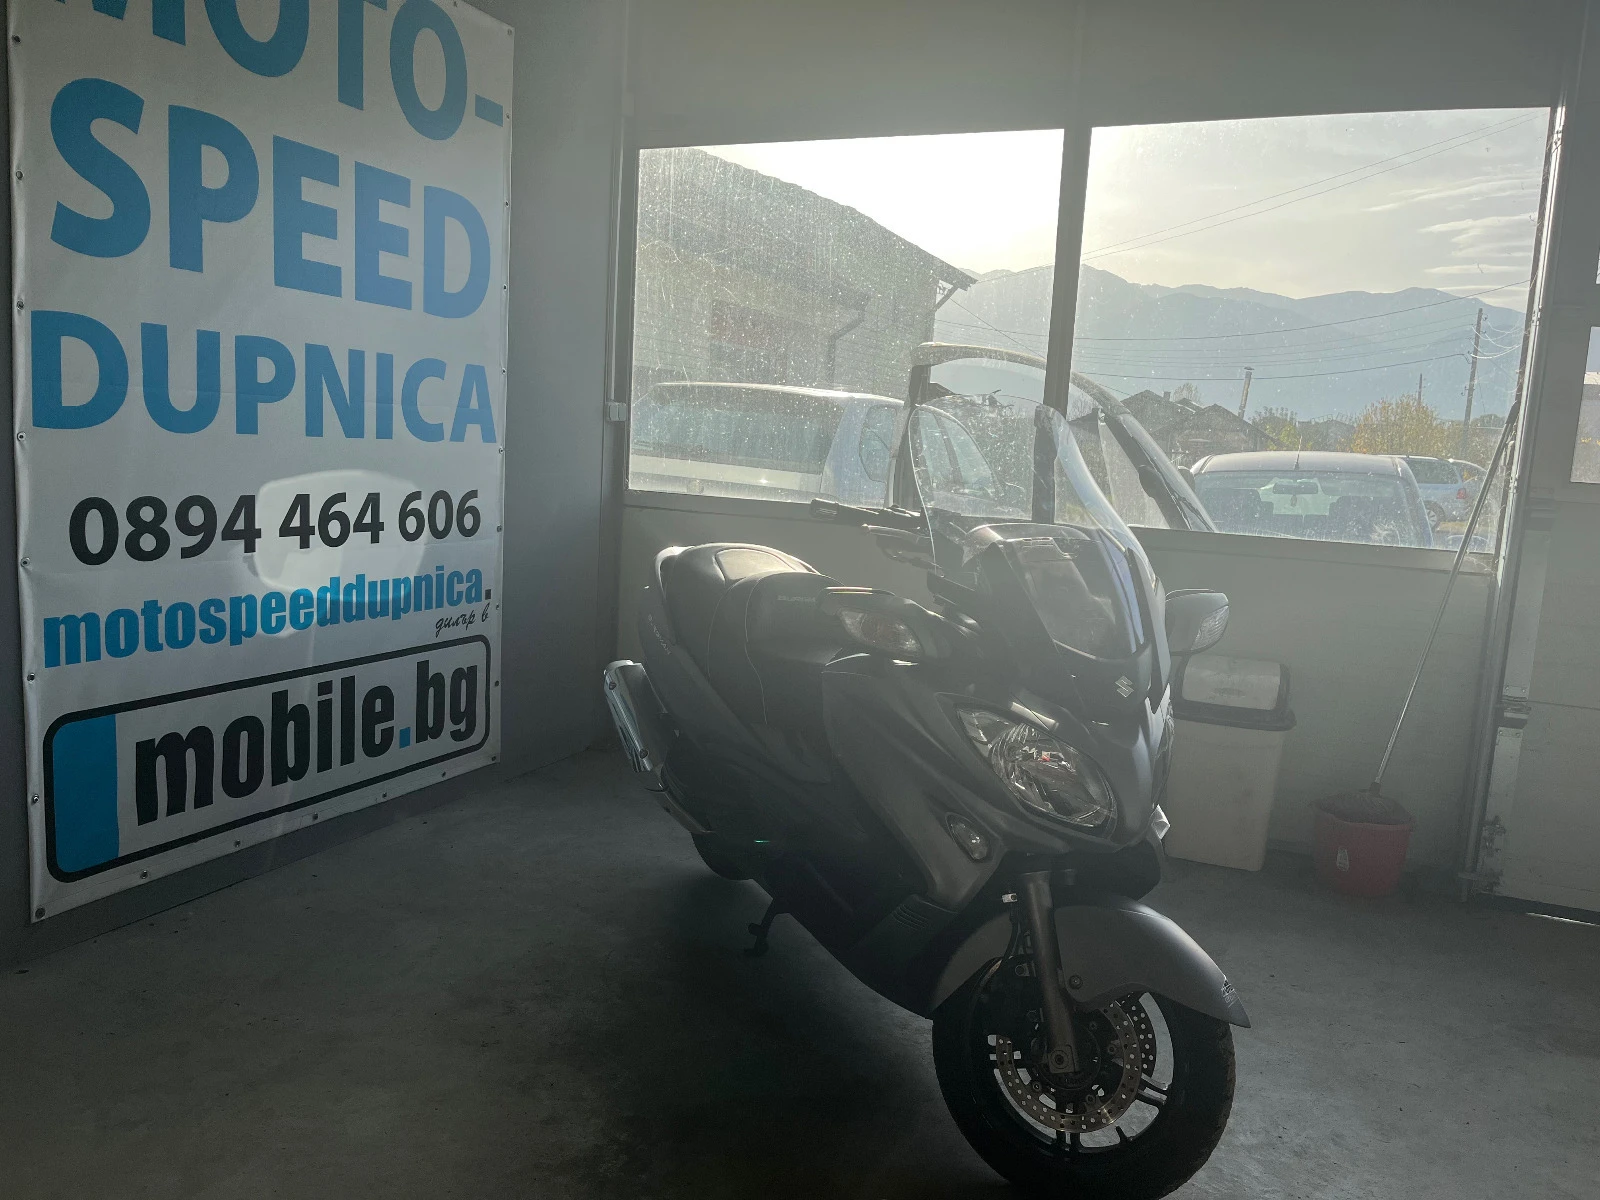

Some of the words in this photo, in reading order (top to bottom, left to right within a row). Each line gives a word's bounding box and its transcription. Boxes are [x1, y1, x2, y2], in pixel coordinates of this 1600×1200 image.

[50, 78, 491, 318] SPEED
[31, 310, 497, 443] DUPNICA
[69, 496, 261, 565] 0894
[278, 492, 385, 549] 464
[398, 489, 481, 542] 606
[135, 660, 478, 826] mobile.bg
